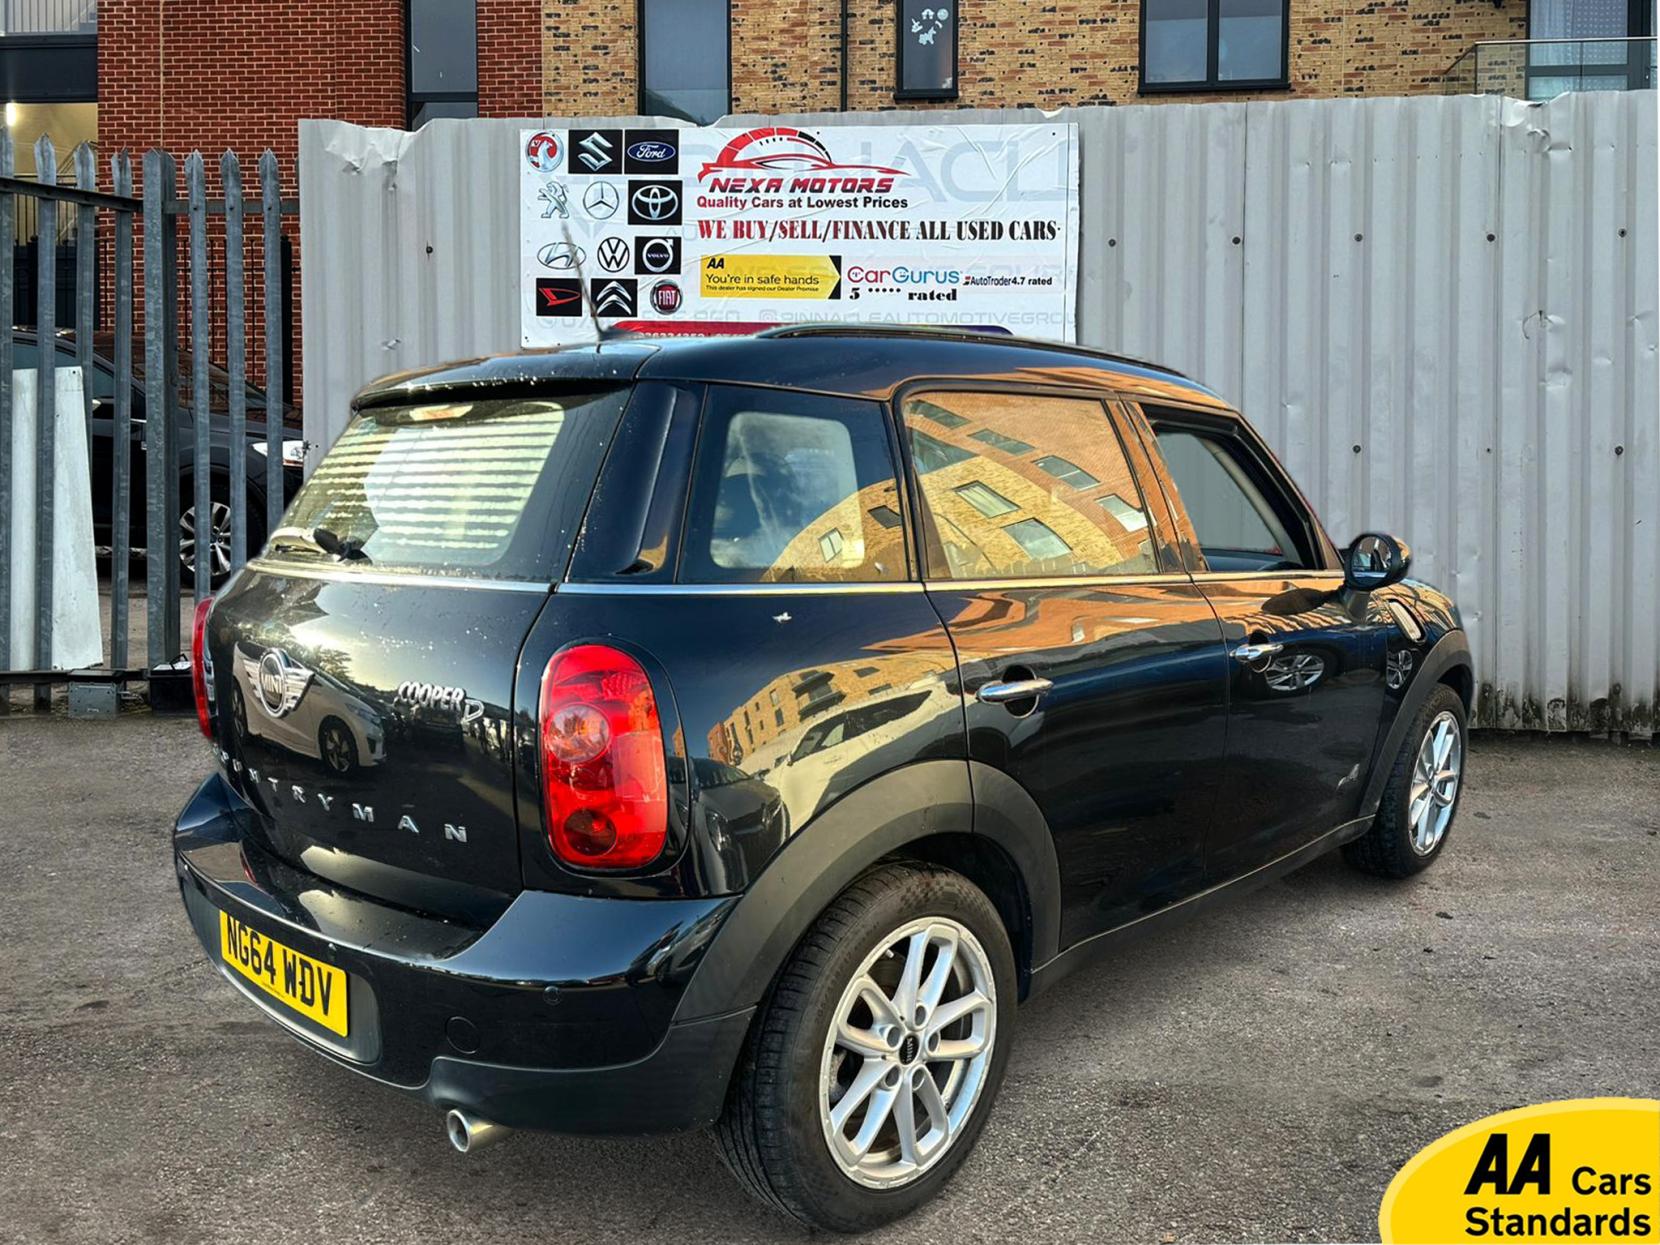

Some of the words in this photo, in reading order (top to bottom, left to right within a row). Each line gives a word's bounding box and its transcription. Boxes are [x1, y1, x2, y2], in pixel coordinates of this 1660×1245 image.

[635, 144, 666, 159] Ford
[709, 178, 783, 193] NEXA
[789, 178, 894, 193] MOTORS
[697, 196, 747, 210] Quality
[752, 196, 784, 208] Cars
[789, 196, 803, 208] at
[807, 196, 859, 208] Lowest
[863, 196, 908, 208] Prices
[697, 220, 727, 240] WE
[917, 220, 950, 240] ALL
[956, 220, 1004, 240] USED
[706, 257, 725, 269] AA
[706, 274, 741, 284] You're
[744, 274, 754, 284] in
[757, 274, 781, 285] safe
[784, 275, 820, 285] hands
[847, 266, 960, 284] CarGurus
[1028, 277, 1053, 286] rated
[658, 289, 675, 306] FIAT
[849, 287, 860, 300] 5
[908, 288, 957, 300] rated
[260, 672, 282, 694] MINI
[398, 681, 464, 711] COOPER
[460, 699, 485, 723] D
[226, 913, 277, 985] NG64
[283, 948, 333, 1017] WDV
